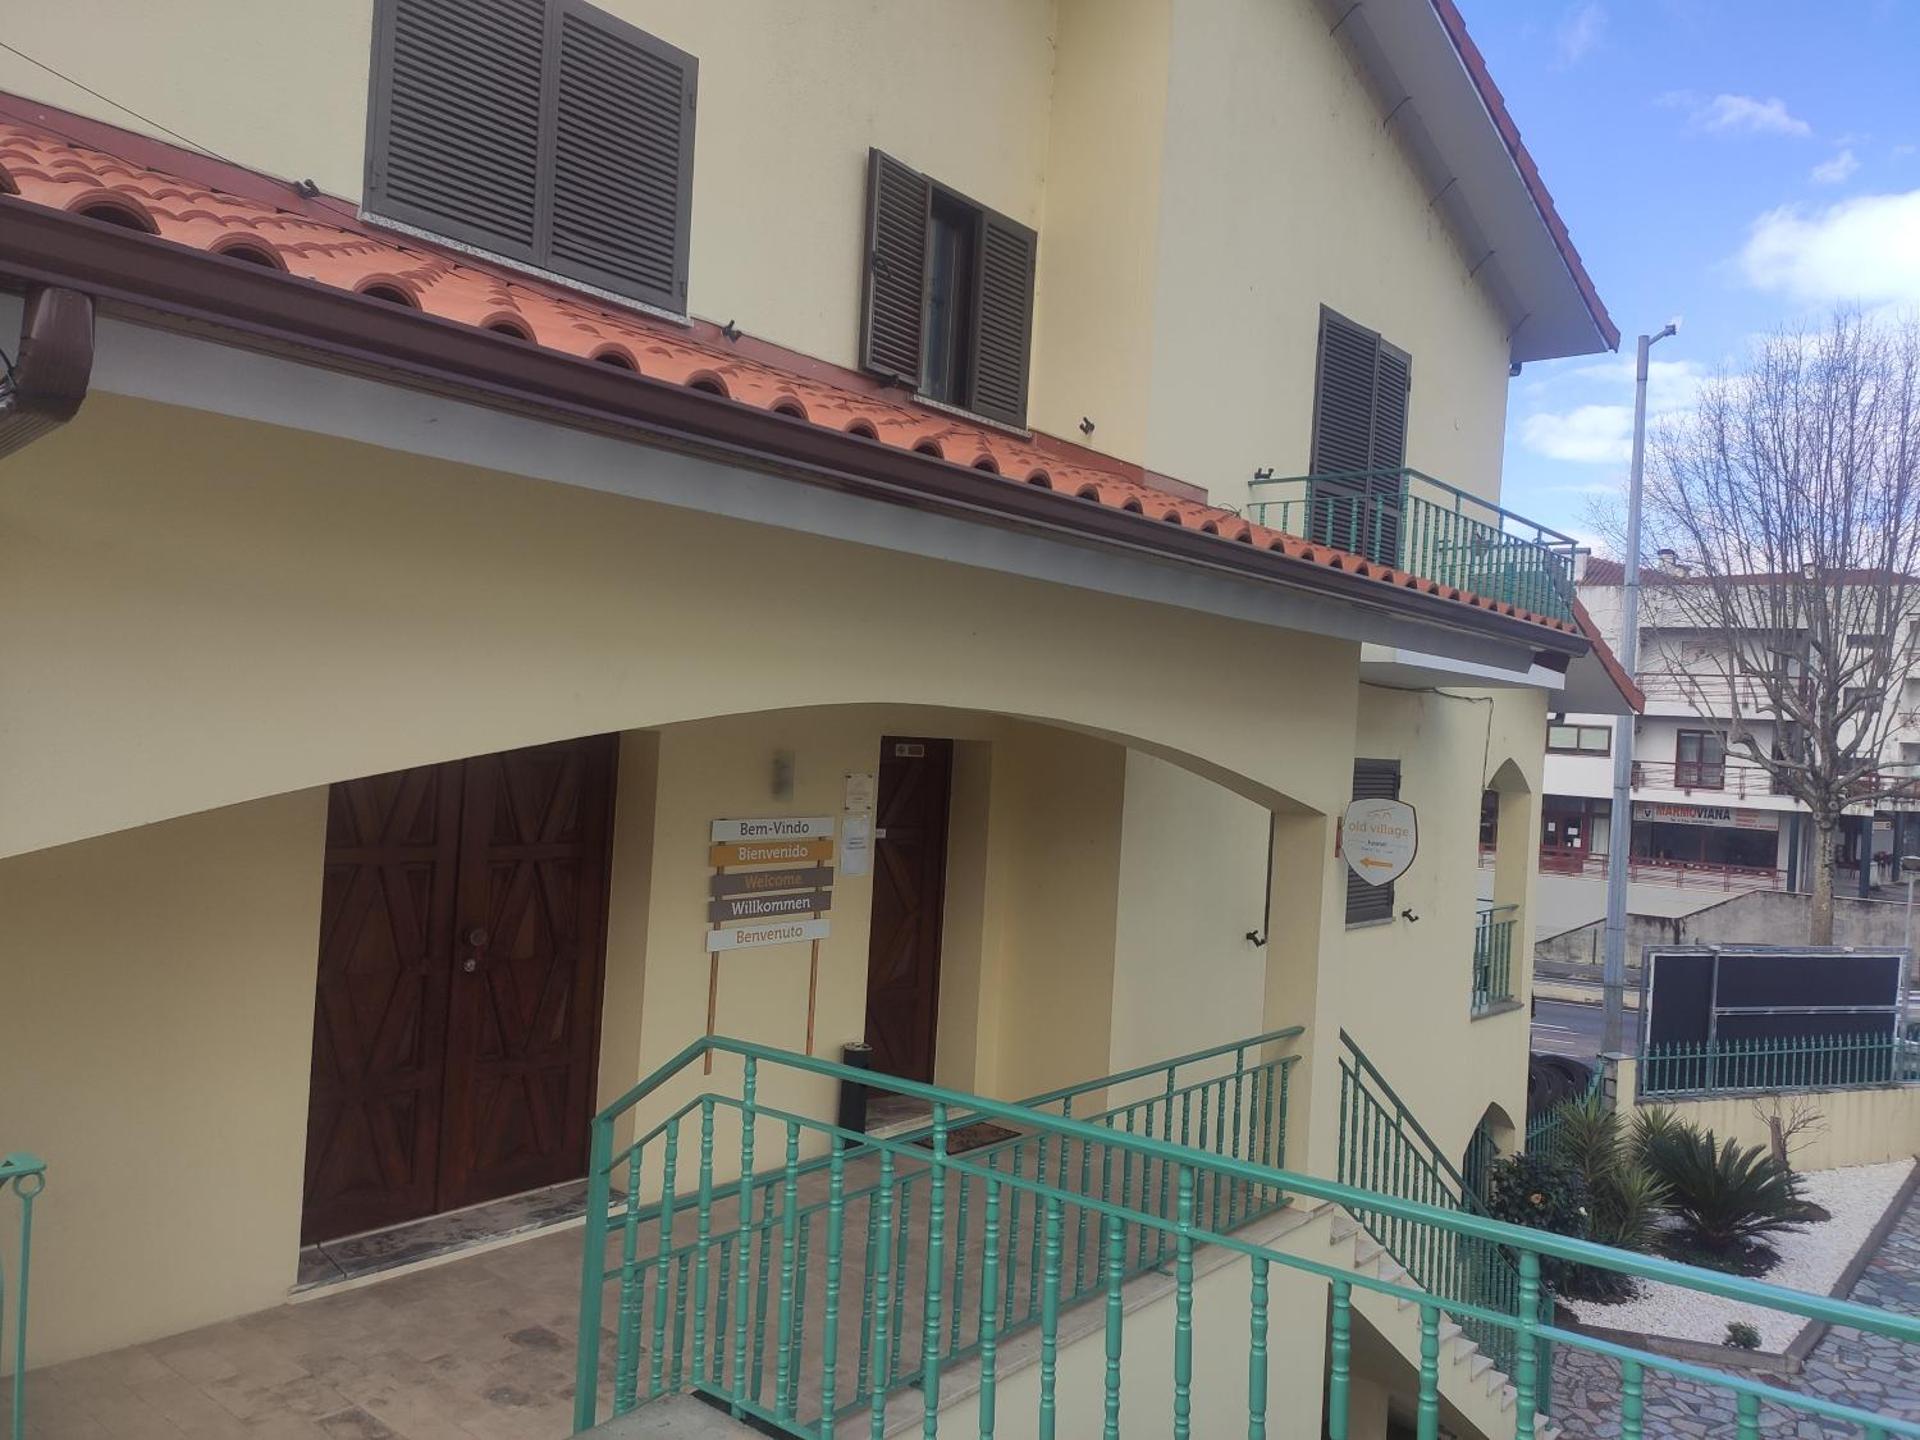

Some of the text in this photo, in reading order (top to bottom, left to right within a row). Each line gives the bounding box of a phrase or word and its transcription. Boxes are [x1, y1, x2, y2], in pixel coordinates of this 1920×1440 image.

[1655, 805, 1731, 820] MARMOVIANA
[740, 821, 810, 836] Bem-Vindo
[1348, 821, 1409, 838] old village
[738, 845, 809, 861] Bienvenido
[744, 873, 802, 889] Welcome
[731, 897, 811, 915] Willkommen
[736, 926, 804, 944] Benvenuto
